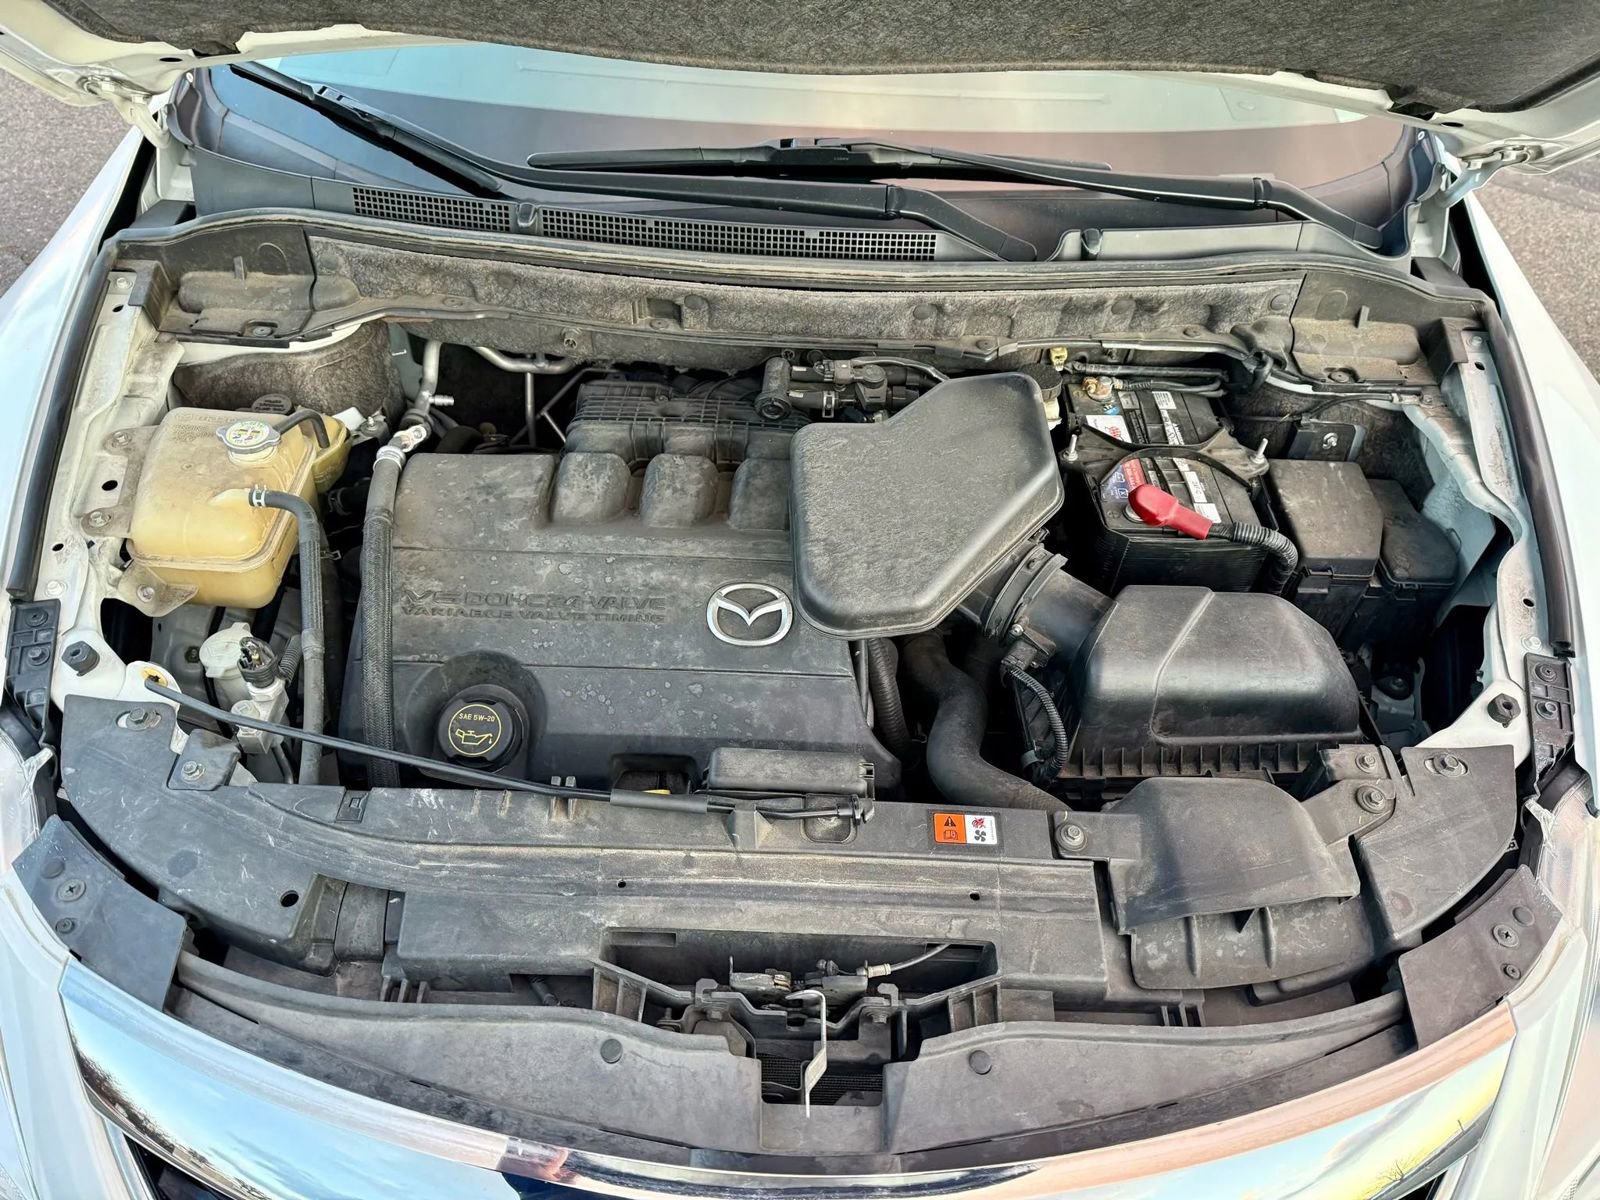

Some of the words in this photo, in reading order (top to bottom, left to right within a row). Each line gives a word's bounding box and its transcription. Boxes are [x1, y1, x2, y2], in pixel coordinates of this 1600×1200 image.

[588, 595, 665, 611] VALVE
[401, 606, 513, 619] VARIABLE
[473, 714, 495, 722] 5W-20
